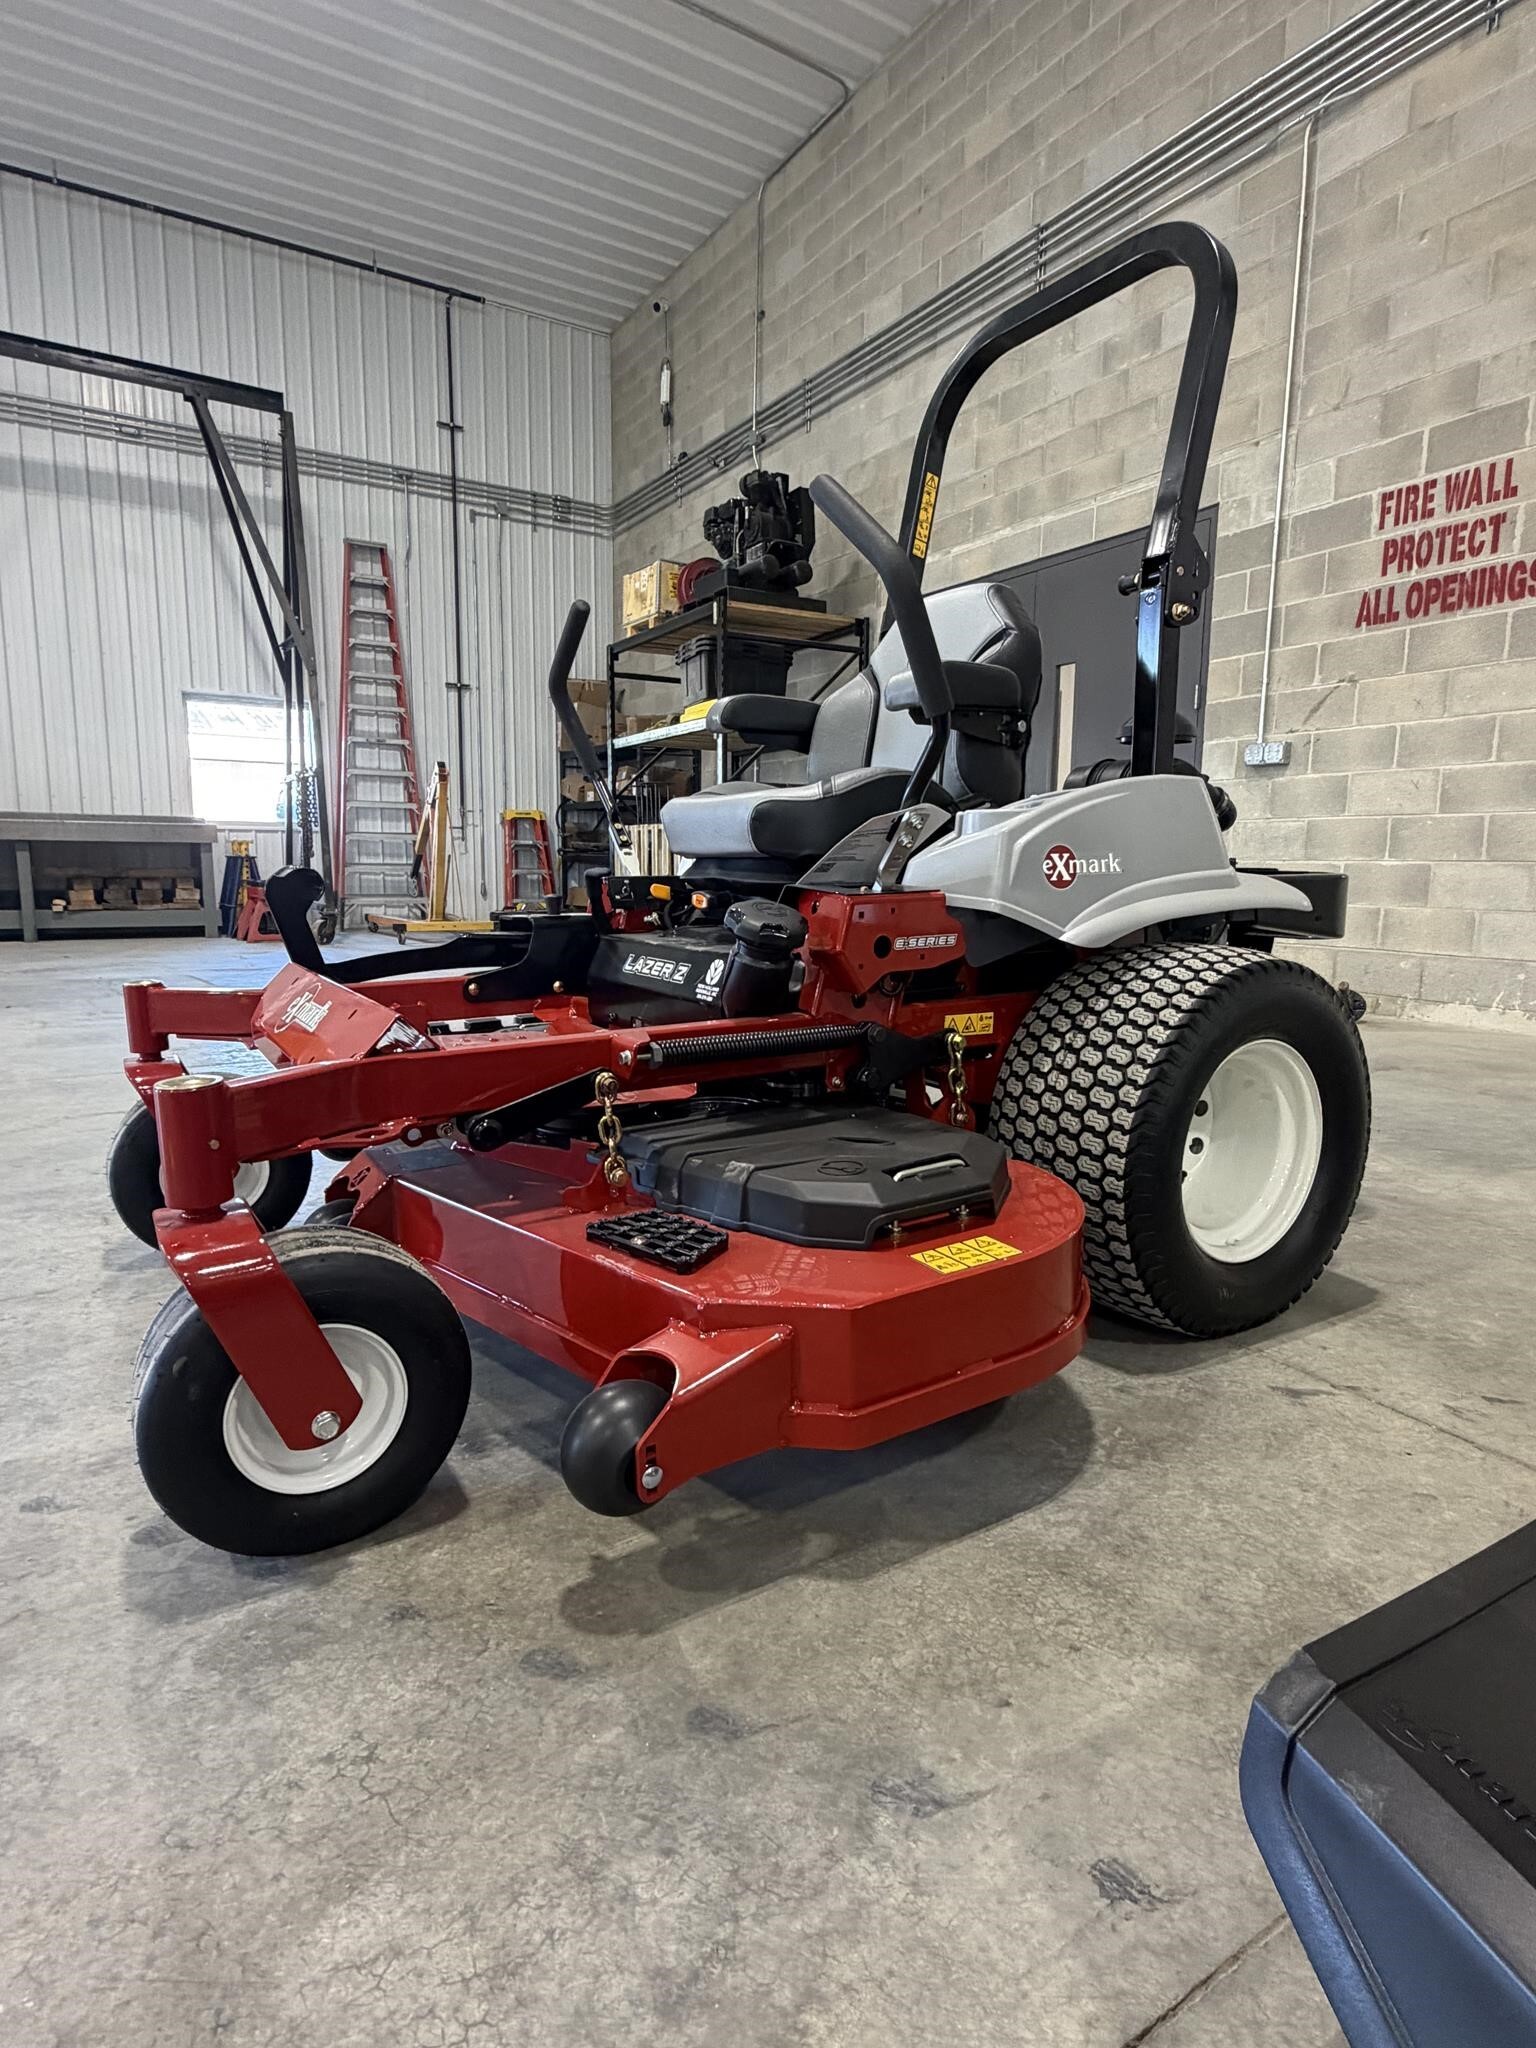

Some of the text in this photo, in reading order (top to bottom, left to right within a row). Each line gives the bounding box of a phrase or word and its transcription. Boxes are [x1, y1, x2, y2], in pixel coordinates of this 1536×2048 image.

[1378, 457, 1519, 531] FIRE WALL
[1380, 511, 1508, 577] PROTECT
[1354, 585, 1400, 628] ALL
[624, 955, 690, 983] LAZER Z
